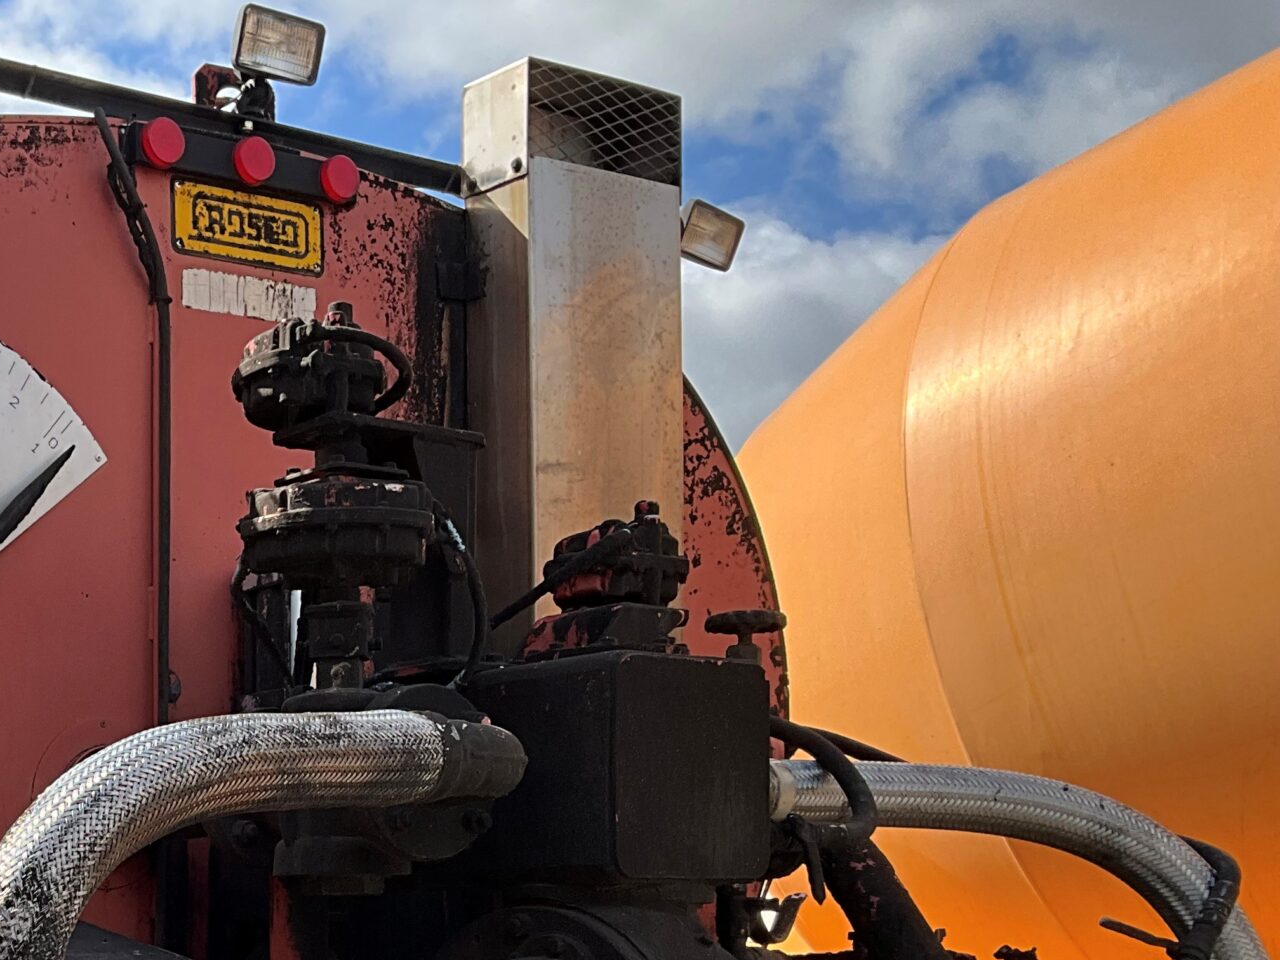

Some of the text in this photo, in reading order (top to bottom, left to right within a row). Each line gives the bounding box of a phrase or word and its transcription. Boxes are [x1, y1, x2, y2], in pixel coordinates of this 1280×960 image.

[8, 395, 21, 410] 2
[47, 436, 59, 450] 0
[31, 442, 41, 454] 1
